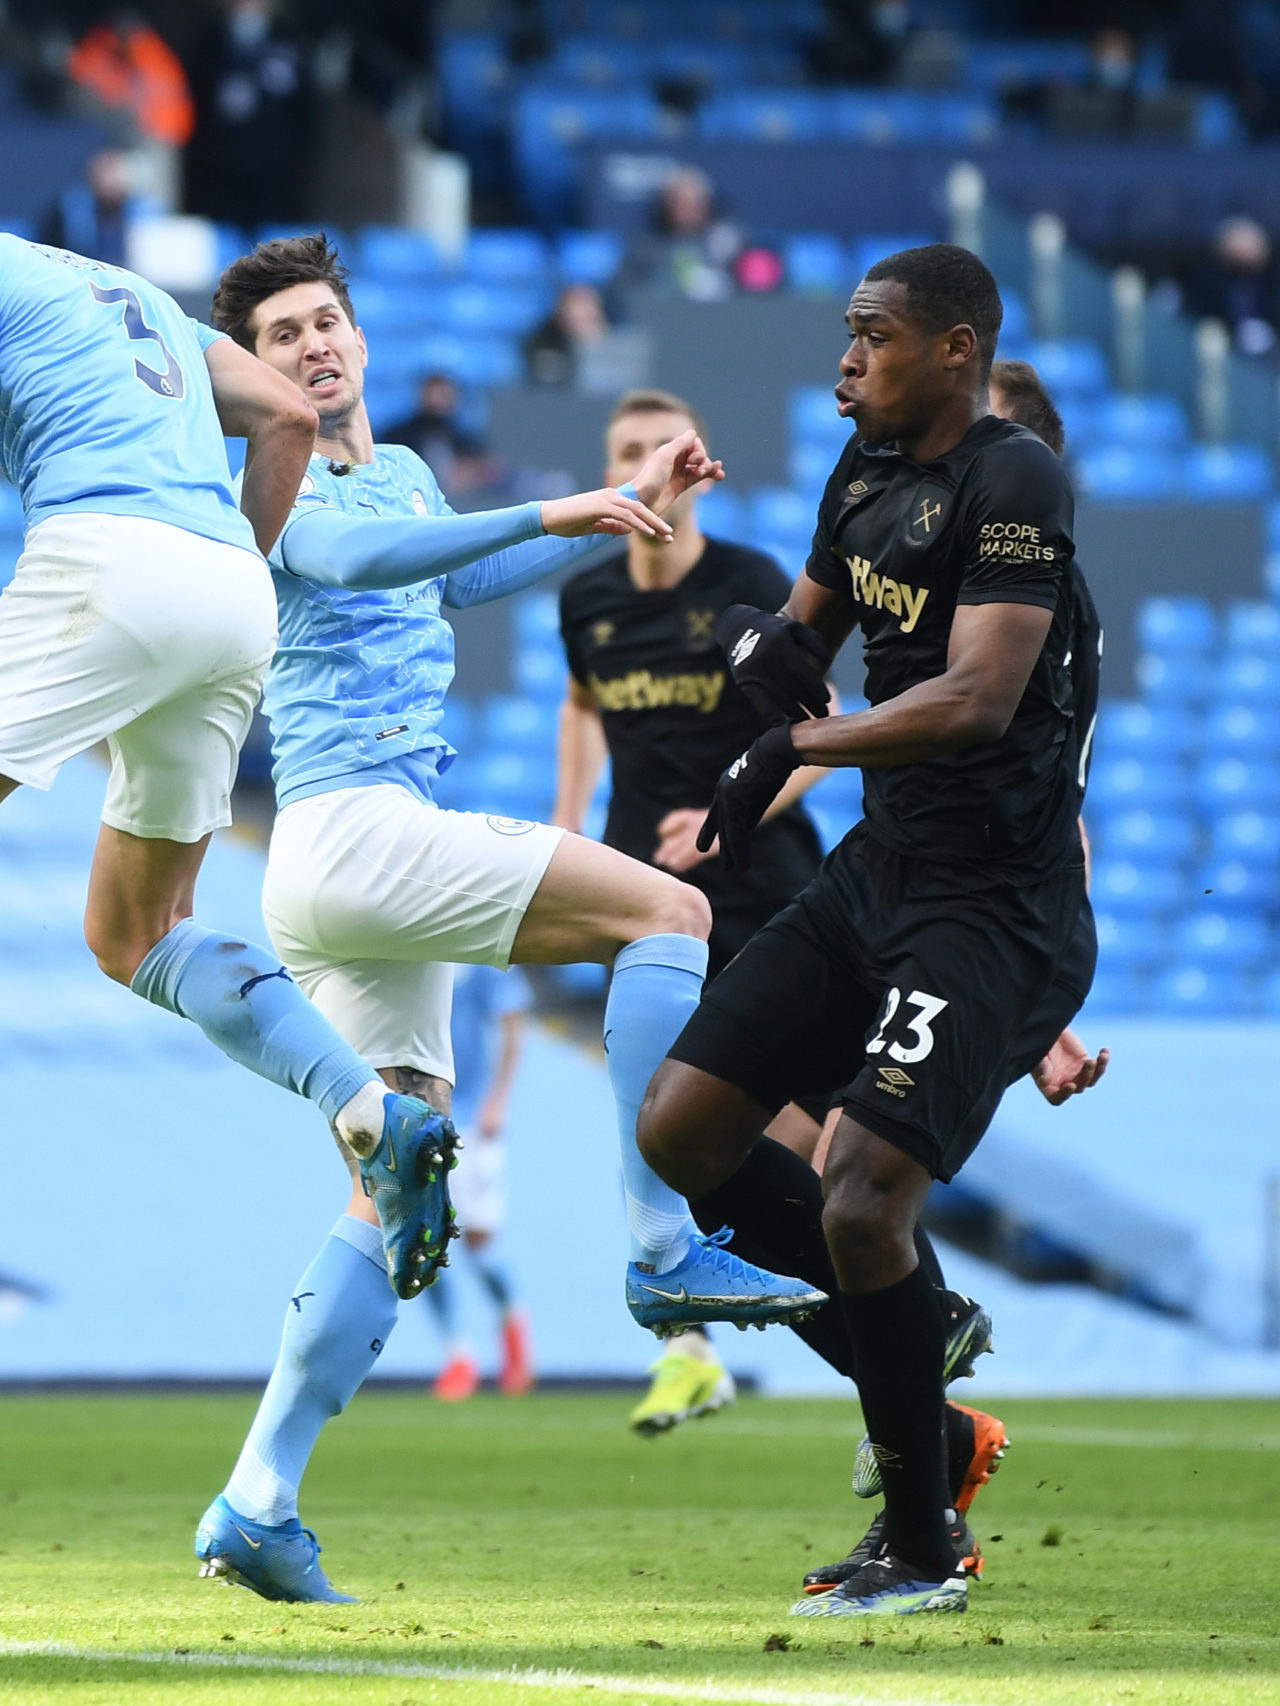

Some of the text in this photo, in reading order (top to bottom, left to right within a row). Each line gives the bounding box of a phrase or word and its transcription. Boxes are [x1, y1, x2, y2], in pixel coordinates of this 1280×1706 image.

[88, 280, 185, 401] 3
[979, 522, 1041, 544] SCOPE
[979, 540, 1056, 561] MARKETS
[845, 555, 930, 633] tway
[865, 986, 950, 1064] 23
[875, 1080, 907, 1099] umbro
